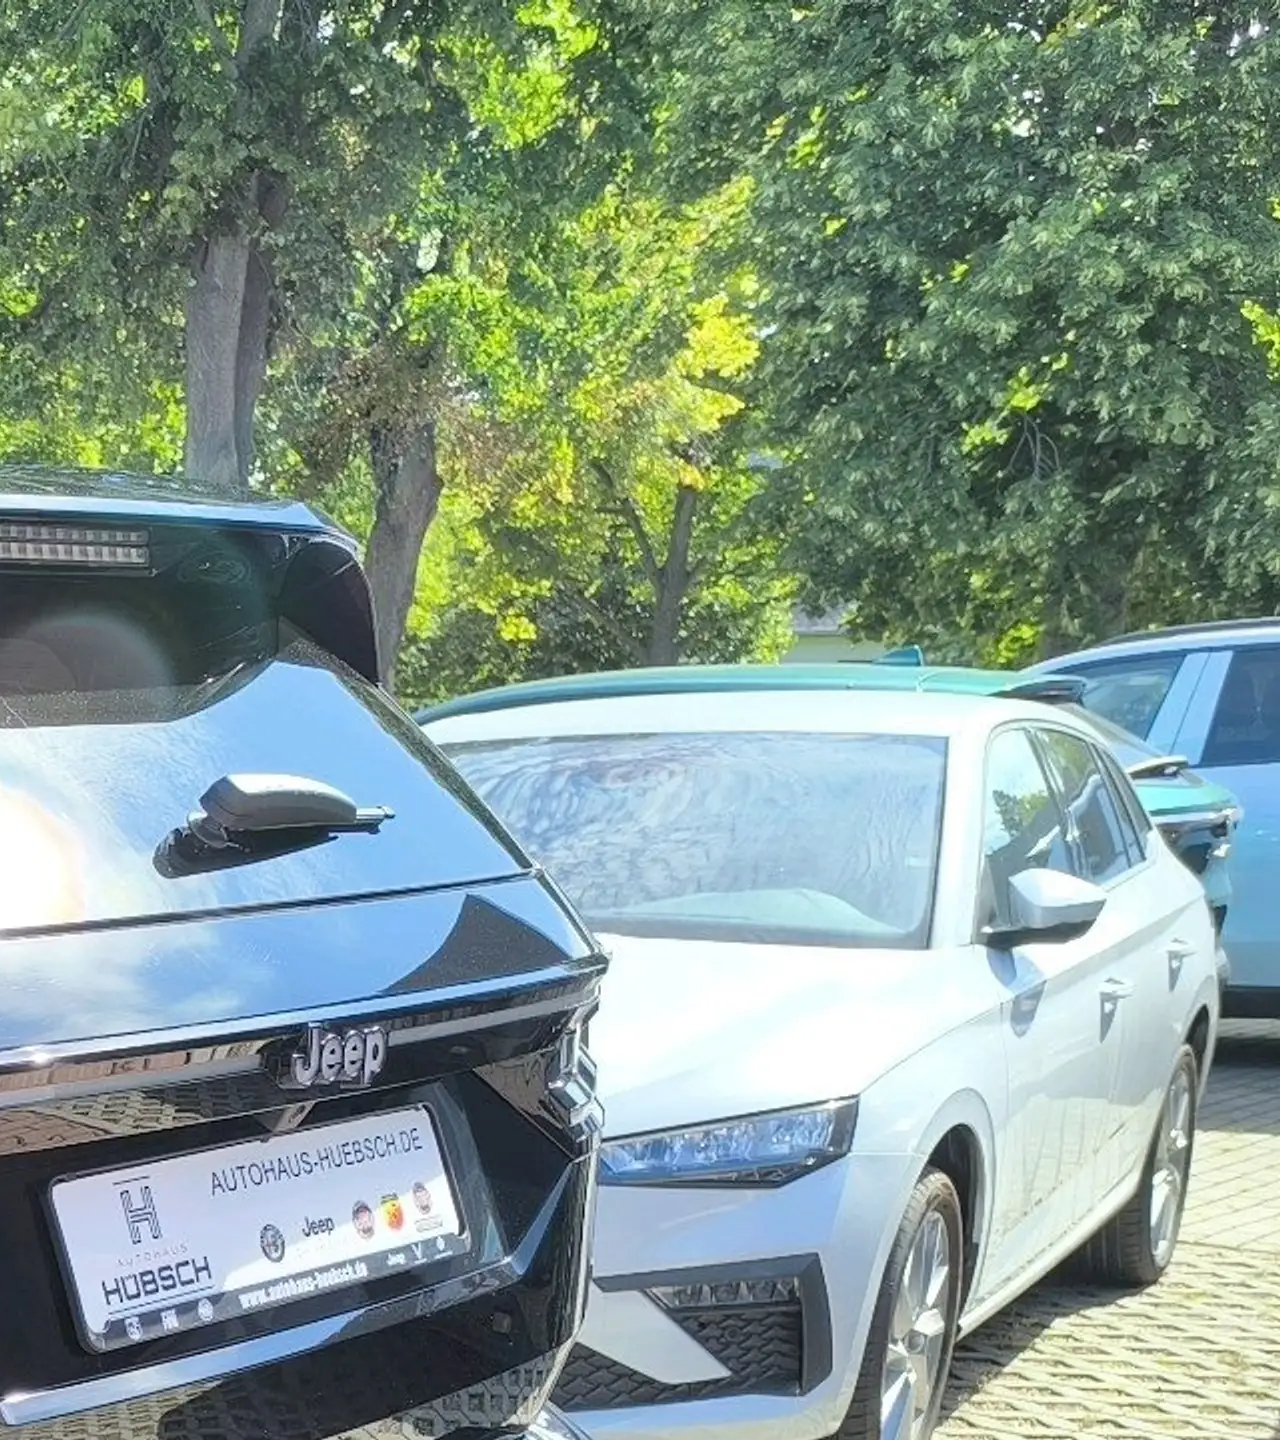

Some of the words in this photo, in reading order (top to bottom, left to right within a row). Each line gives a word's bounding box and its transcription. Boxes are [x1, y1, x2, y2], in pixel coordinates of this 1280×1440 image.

[292, 1022, 389, 1087] Jeep
[210, 1127, 424, 1198] AUTOHAUS-HUEBSCH.DE
[301, 1216, 336, 1238] Jeep
[101, 1255, 213, 1306] HÜBSCH
